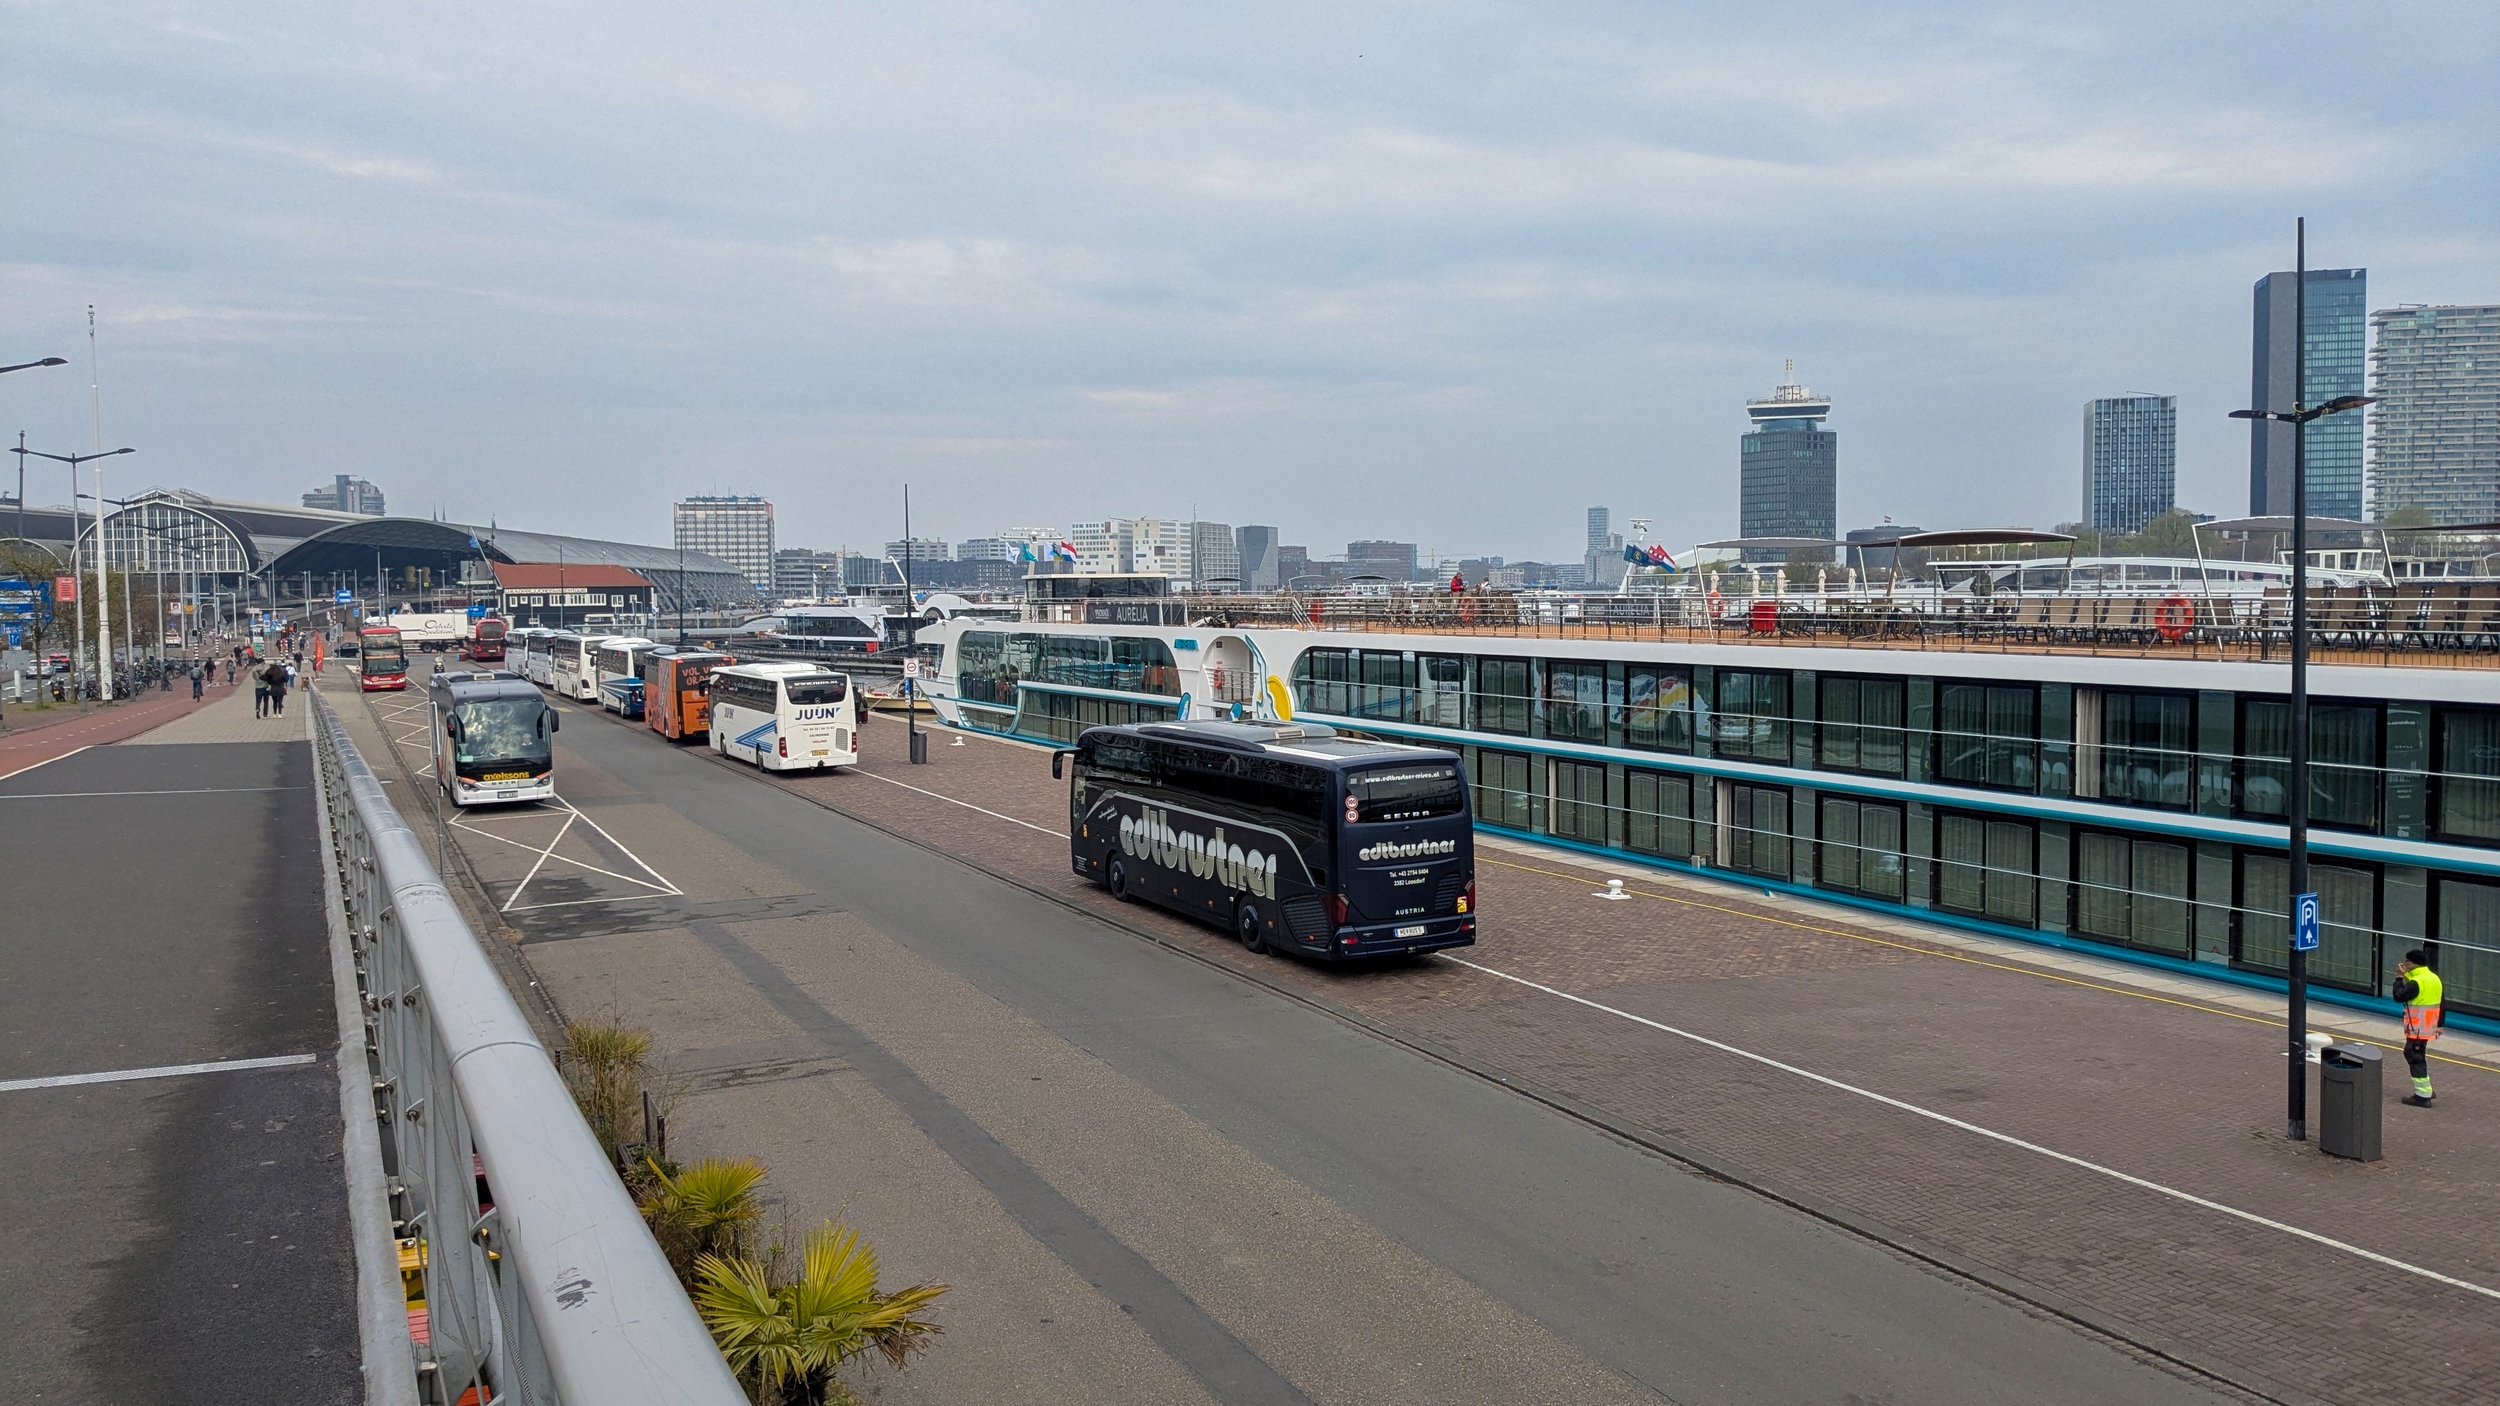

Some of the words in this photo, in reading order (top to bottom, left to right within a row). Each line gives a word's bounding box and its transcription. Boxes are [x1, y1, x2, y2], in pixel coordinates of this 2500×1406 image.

[1116, 606, 1149, 622] AURELIA
[682, 666, 701, 677] VOL
[483, 771, 530, 781] axelssons
[1383, 810, 1430, 820] SETRA
[1119, 805, 1277, 900] edtbrustner
[1359, 839, 1455, 861] edtbrustner
[1395, 907, 1425, 916] AUSTRIA
